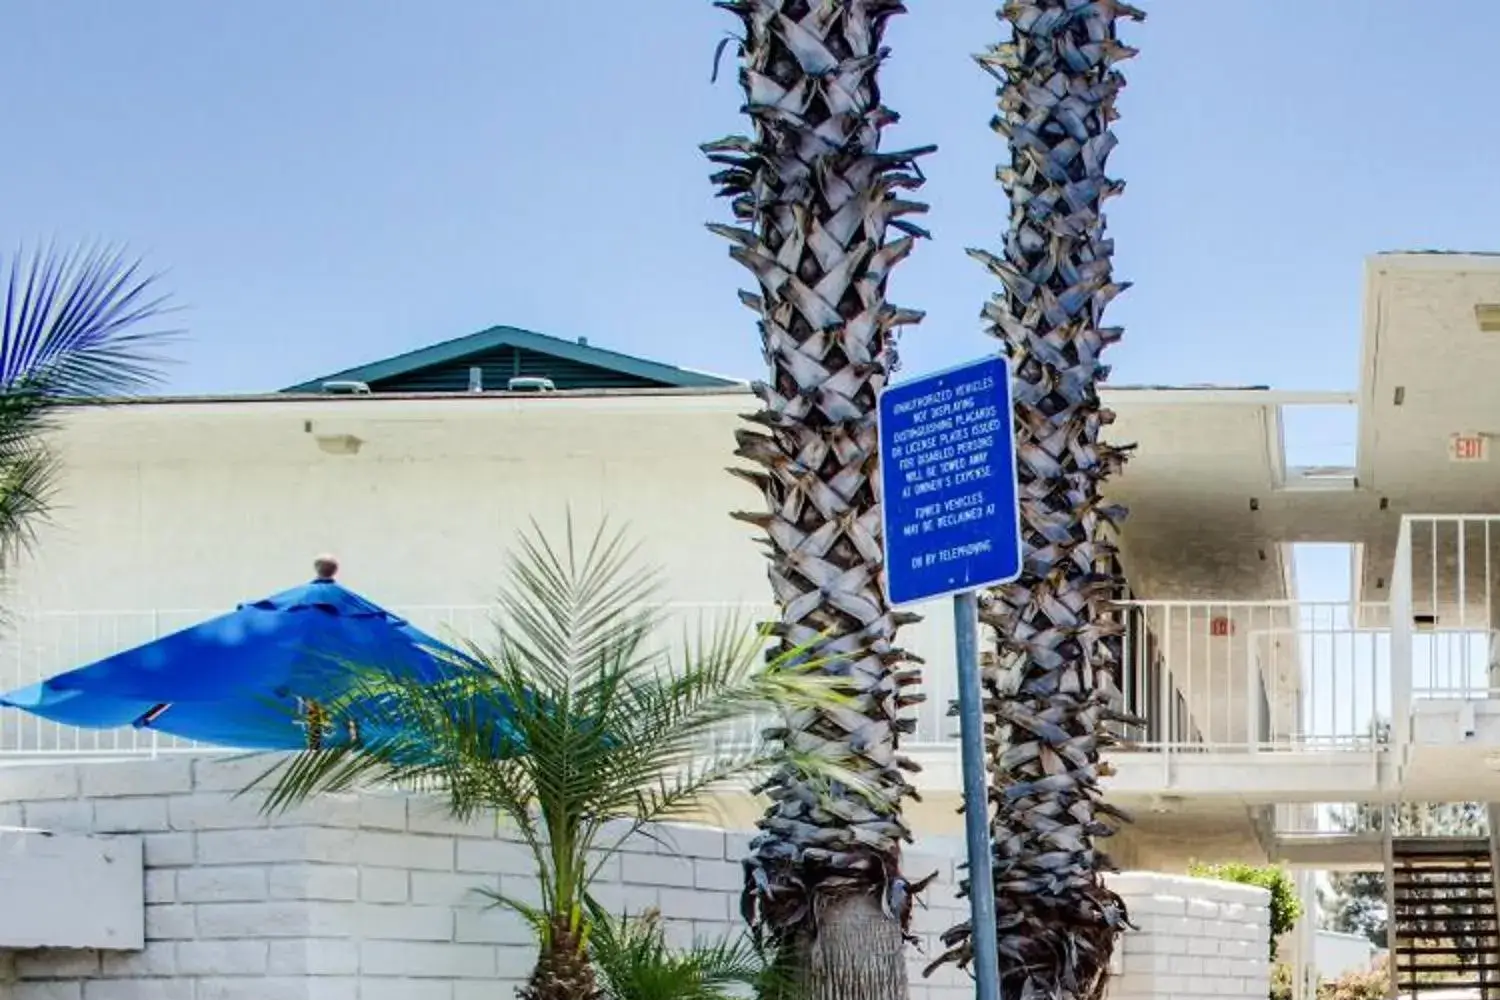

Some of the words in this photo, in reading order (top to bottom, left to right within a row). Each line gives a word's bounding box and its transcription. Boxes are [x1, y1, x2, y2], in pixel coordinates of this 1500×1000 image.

[893, 389, 953, 416] UNAUTHORIZED
[955, 376, 995, 396] VEHICLES
[913, 410, 928, 423] NOT
[931, 396, 975, 419] DISPLAYING
[891, 446, 903, 459] OR
[905, 435, 937, 455] LICENSE
[939, 428, 969, 445] PLATES
[971, 418, 1001, 435] ISSUED
[893, 417, 953, 443] DISTINGUISHING
[955, 405, 998, 426] PLACARDS
[899, 457, 915, 471] FOR
[917, 446, 955, 466] DISABLED
[957, 435, 993, 454] PERSONS
[905, 469, 922, 483] WILL
[925, 466, 937, 478] BE
[940, 457, 967, 473] TOWED
[969, 452, 988, 465] AWAY
[902, 486, 911, 498] AT
[915, 503, 941, 519] TOWED
[944, 491, 984, 512] VEHICLES
[903, 523, 919, 536] MAY
[922, 519, 933, 533] BE
[937, 507, 983, 528] RECLAIMED
[986, 503, 995, 516] AT
[911, 556, 923, 569] OR
[925, 553, 937, 567] BY
[940, 539, 992, 562] TELEPHONING
